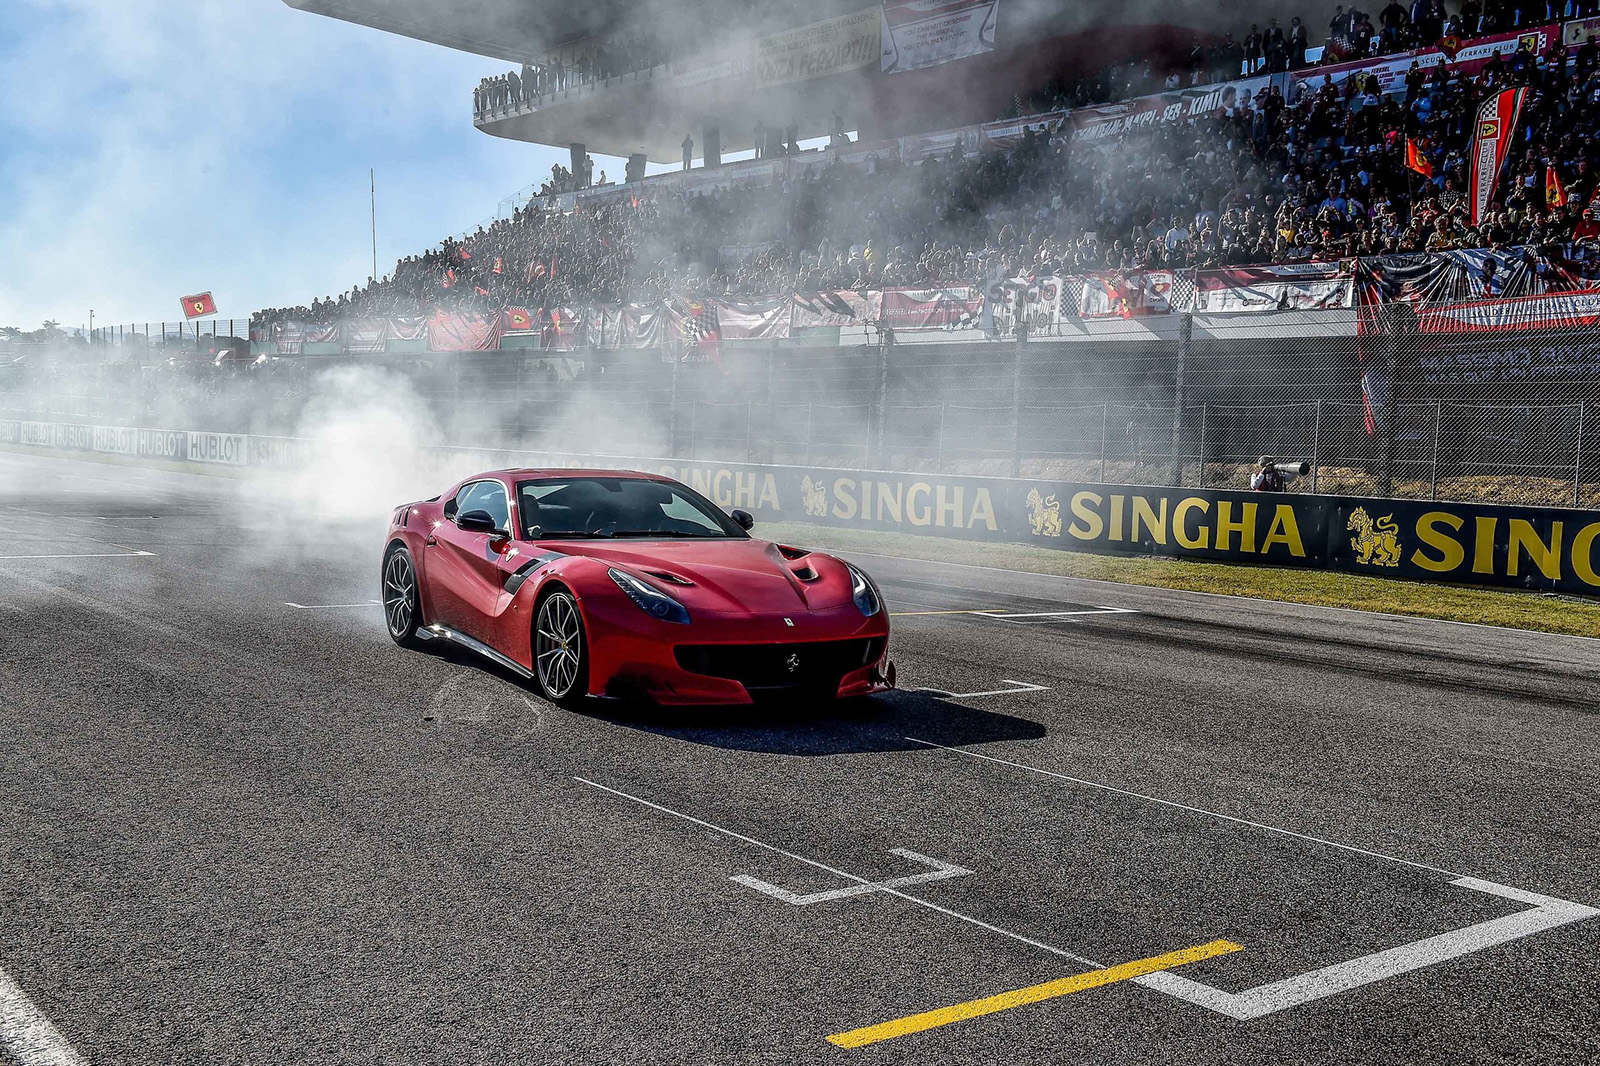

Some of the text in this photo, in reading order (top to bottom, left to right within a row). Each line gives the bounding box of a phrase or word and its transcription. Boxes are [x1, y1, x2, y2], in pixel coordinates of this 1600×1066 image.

[1460, 47, 1491, 58] FERRARI
[1162, 102, 1184, 123] SEB
[1188, 92, 1222, 117] KIMI
[22, 422, 52, 444] HUBLOT
[56, 424, 90, 447] HUBLOT
[95, 428, 134, 451] HUBLOT
[140, 430, 185, 457] HUBLOT
[190, 433, 243, 462] HUBLOT
[832, 477, 998, 532] SINGHA
[1068, 491, 1306, 557] SINGHA
